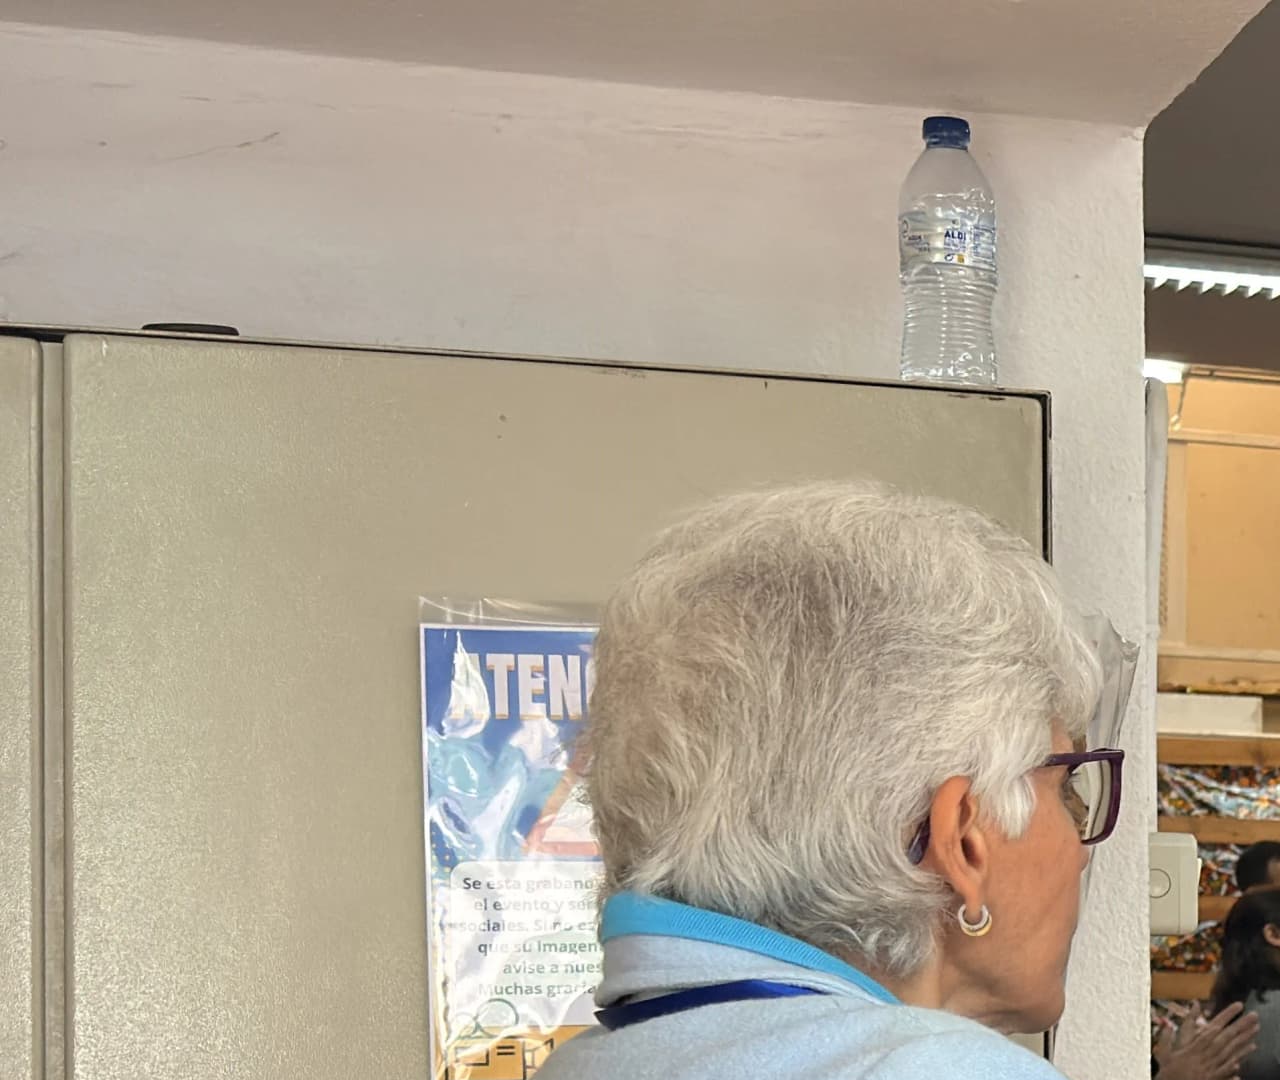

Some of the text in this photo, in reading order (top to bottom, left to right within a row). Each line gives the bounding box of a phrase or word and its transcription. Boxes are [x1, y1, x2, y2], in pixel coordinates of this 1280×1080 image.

[944, 230, 966, 241] ALDI
[463, 877, 482, 890] Se
[474, 897, 488, 911] el
[493, 898, 550, 912] evento
[478, 943, 509, 957] que
[514, 943, 532, 953] su
[503, 961, 545, 974] avise
[550, 964, 559, 973] a
[479, 982, 543, 996] Muchas
